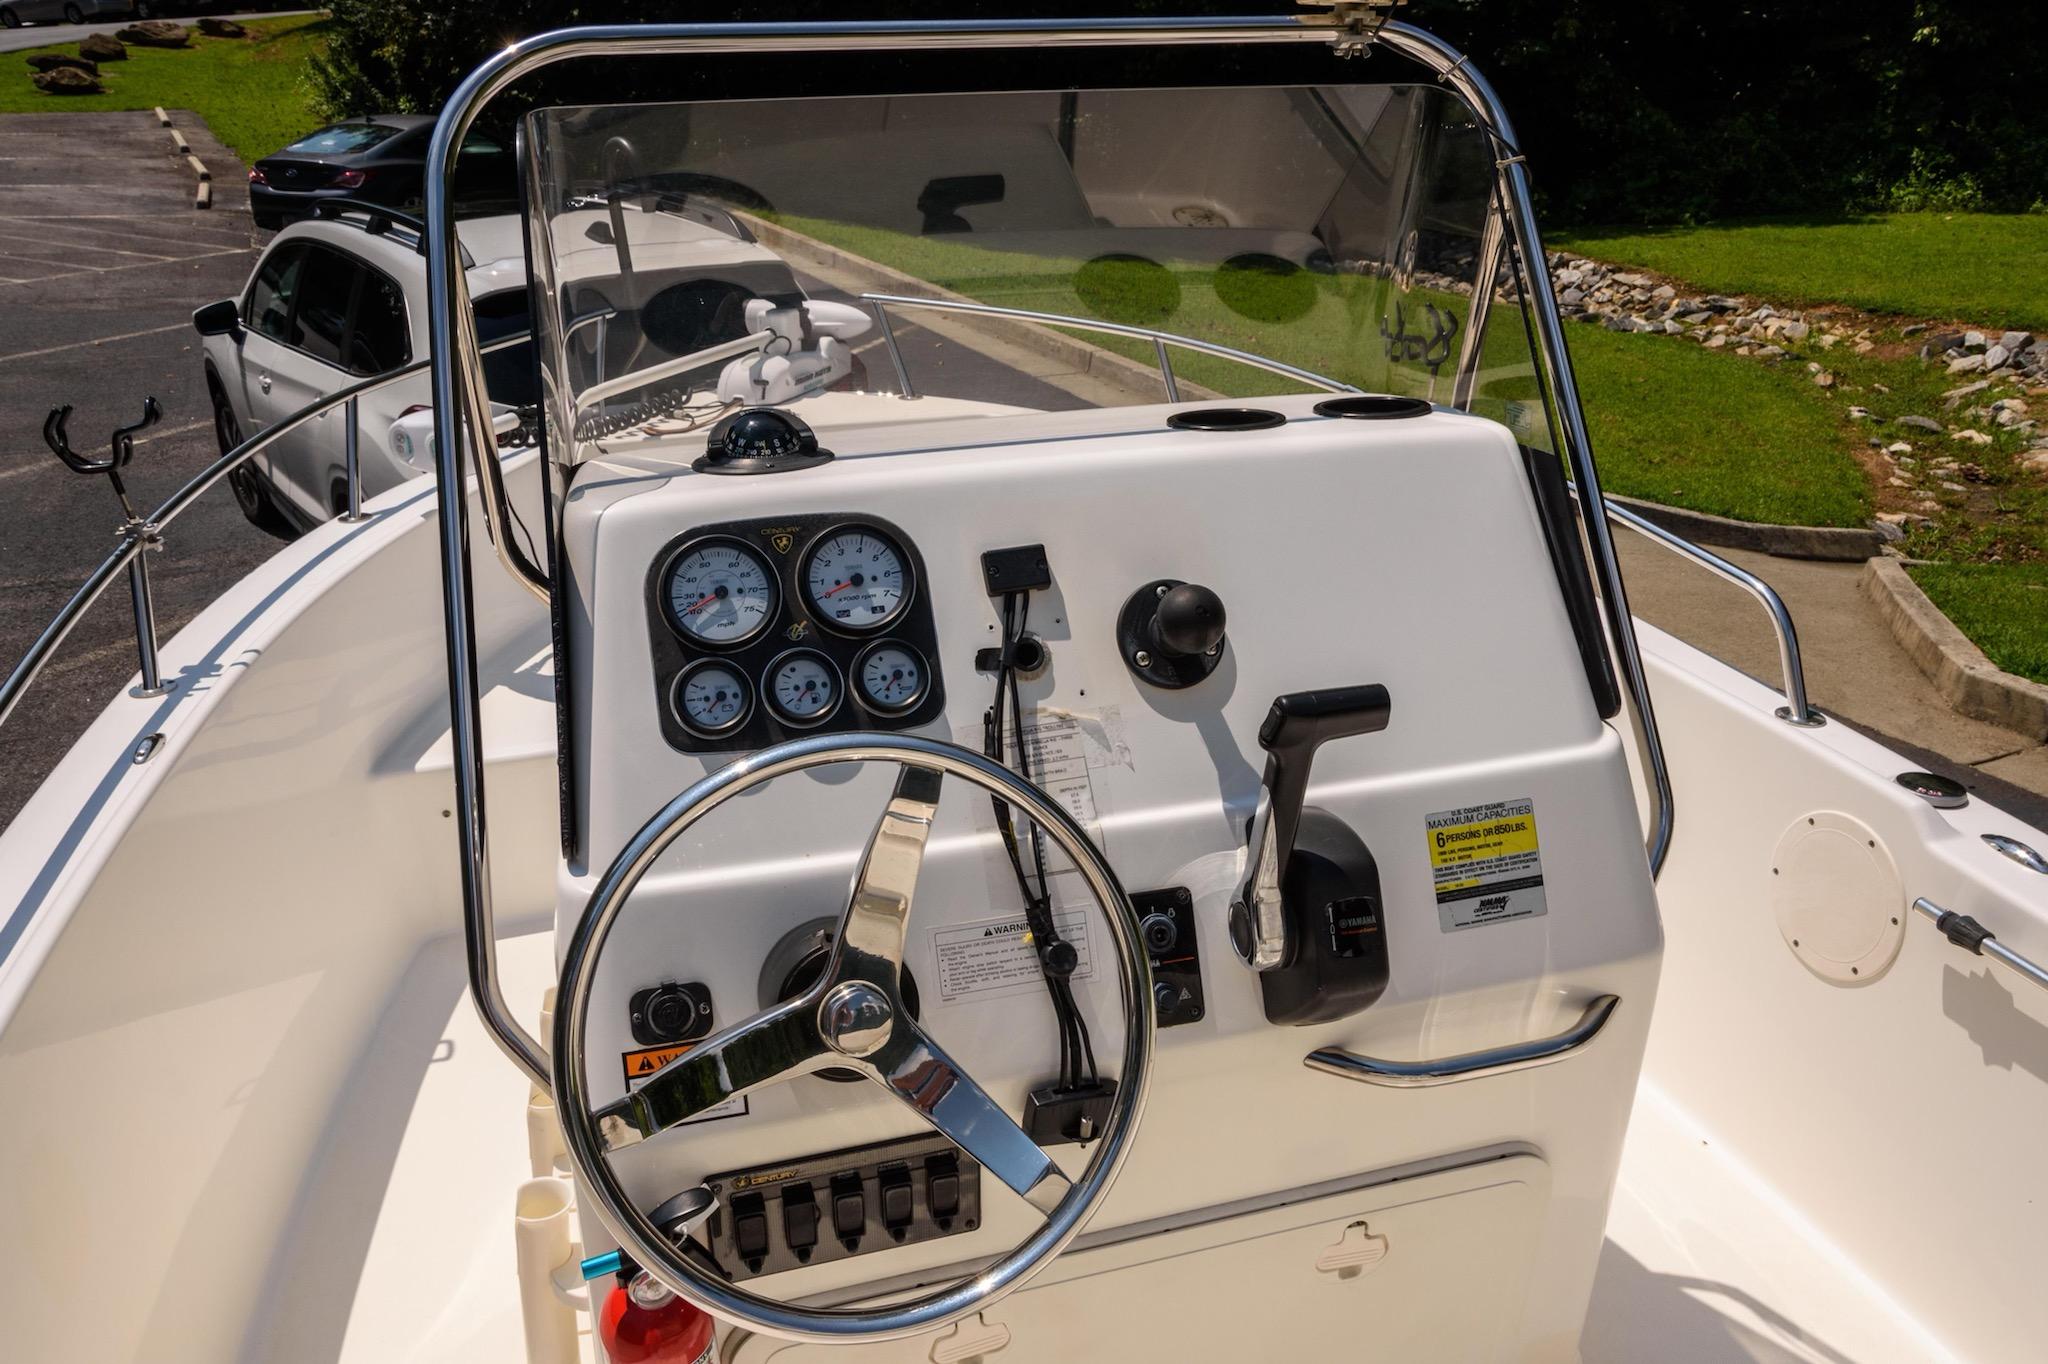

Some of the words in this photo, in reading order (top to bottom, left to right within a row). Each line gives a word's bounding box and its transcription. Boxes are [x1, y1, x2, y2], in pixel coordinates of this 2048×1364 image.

[872, 554, 880, 562] 5
[883, 570, 891, 578] 6
[861, 593, 877, 601] rpm
[1463, 805, 1483, 815] COAST
[1484, 802, 1506, 811] GUARD
[1428, 813, 1475, 829] MAXIMUM
[1476, 804, 1531, 820] CAPACITIES
[1436, 831, 1446, 848] 6
[1446, 829, 1481, 843] PERSONS
[1483, 827, 1494, 837] OR
[1494, 823, 1511, 835] 850
[1510, 822, 1528, 833] LBS.
[1347, 913, 1377, 927] YAMAHA
[752, 1169, 799, 1184] CENTURY
